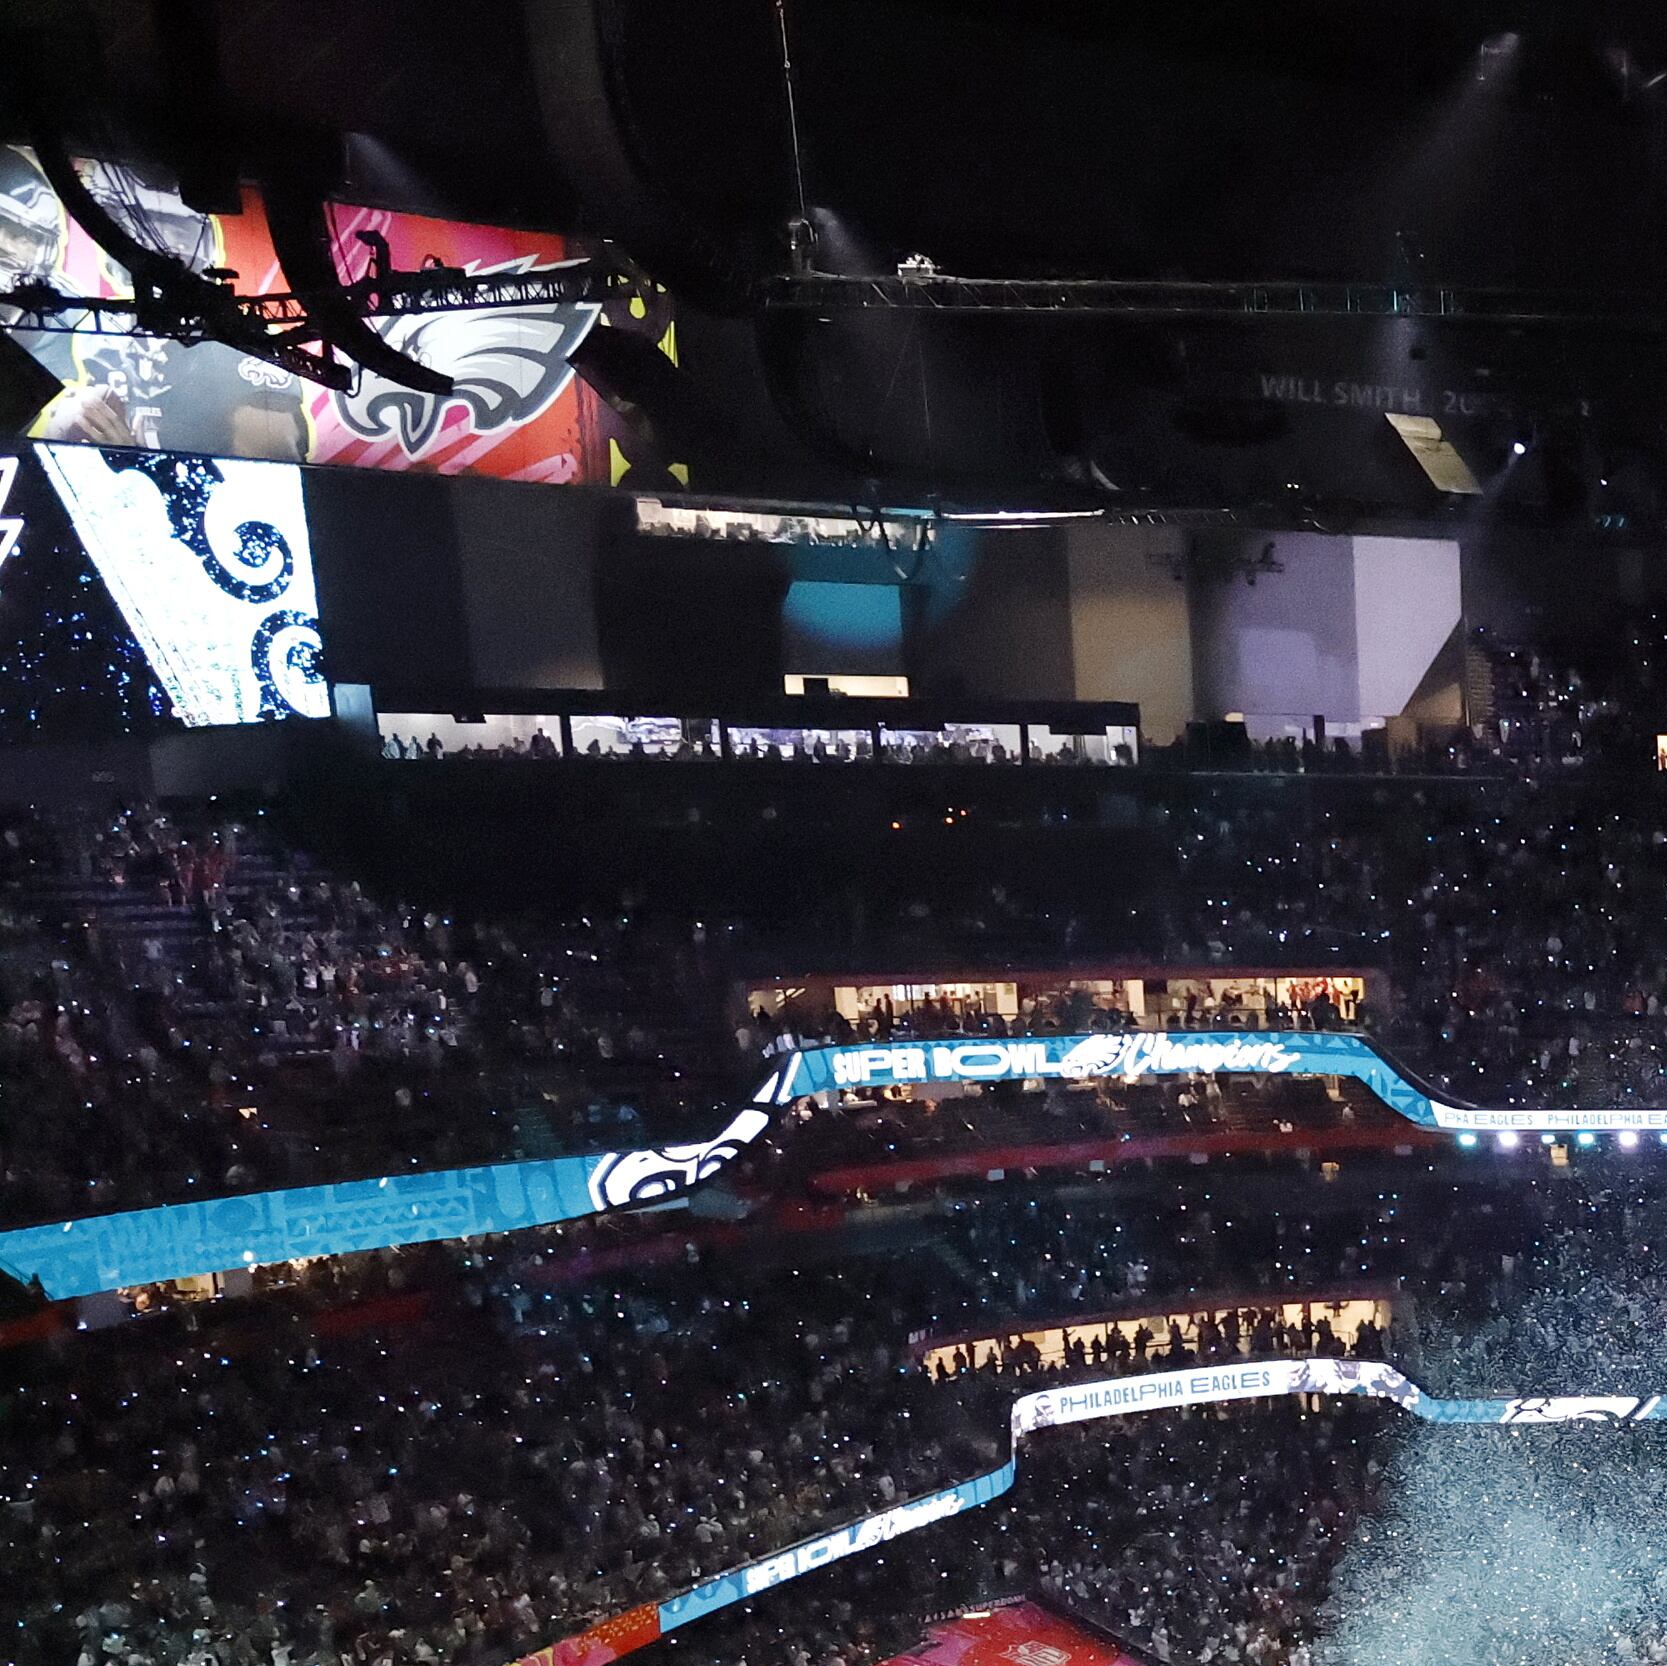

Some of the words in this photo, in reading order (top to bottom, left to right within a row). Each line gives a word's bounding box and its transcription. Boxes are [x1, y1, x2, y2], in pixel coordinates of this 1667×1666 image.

[1260, 376, 1322, 402] WILL
[1333, 382, 1423, 410] SMITH
[834, 1046, 926, 1085] SUPER
[934, 1042, 1062, 1078] BOWL
[1123, 1032, 1301, 1077] Champions
[1060, 1380, 1184, 1414] PHILADELPHIA
[1190, 1370, 1271, 1395] EAGLES
